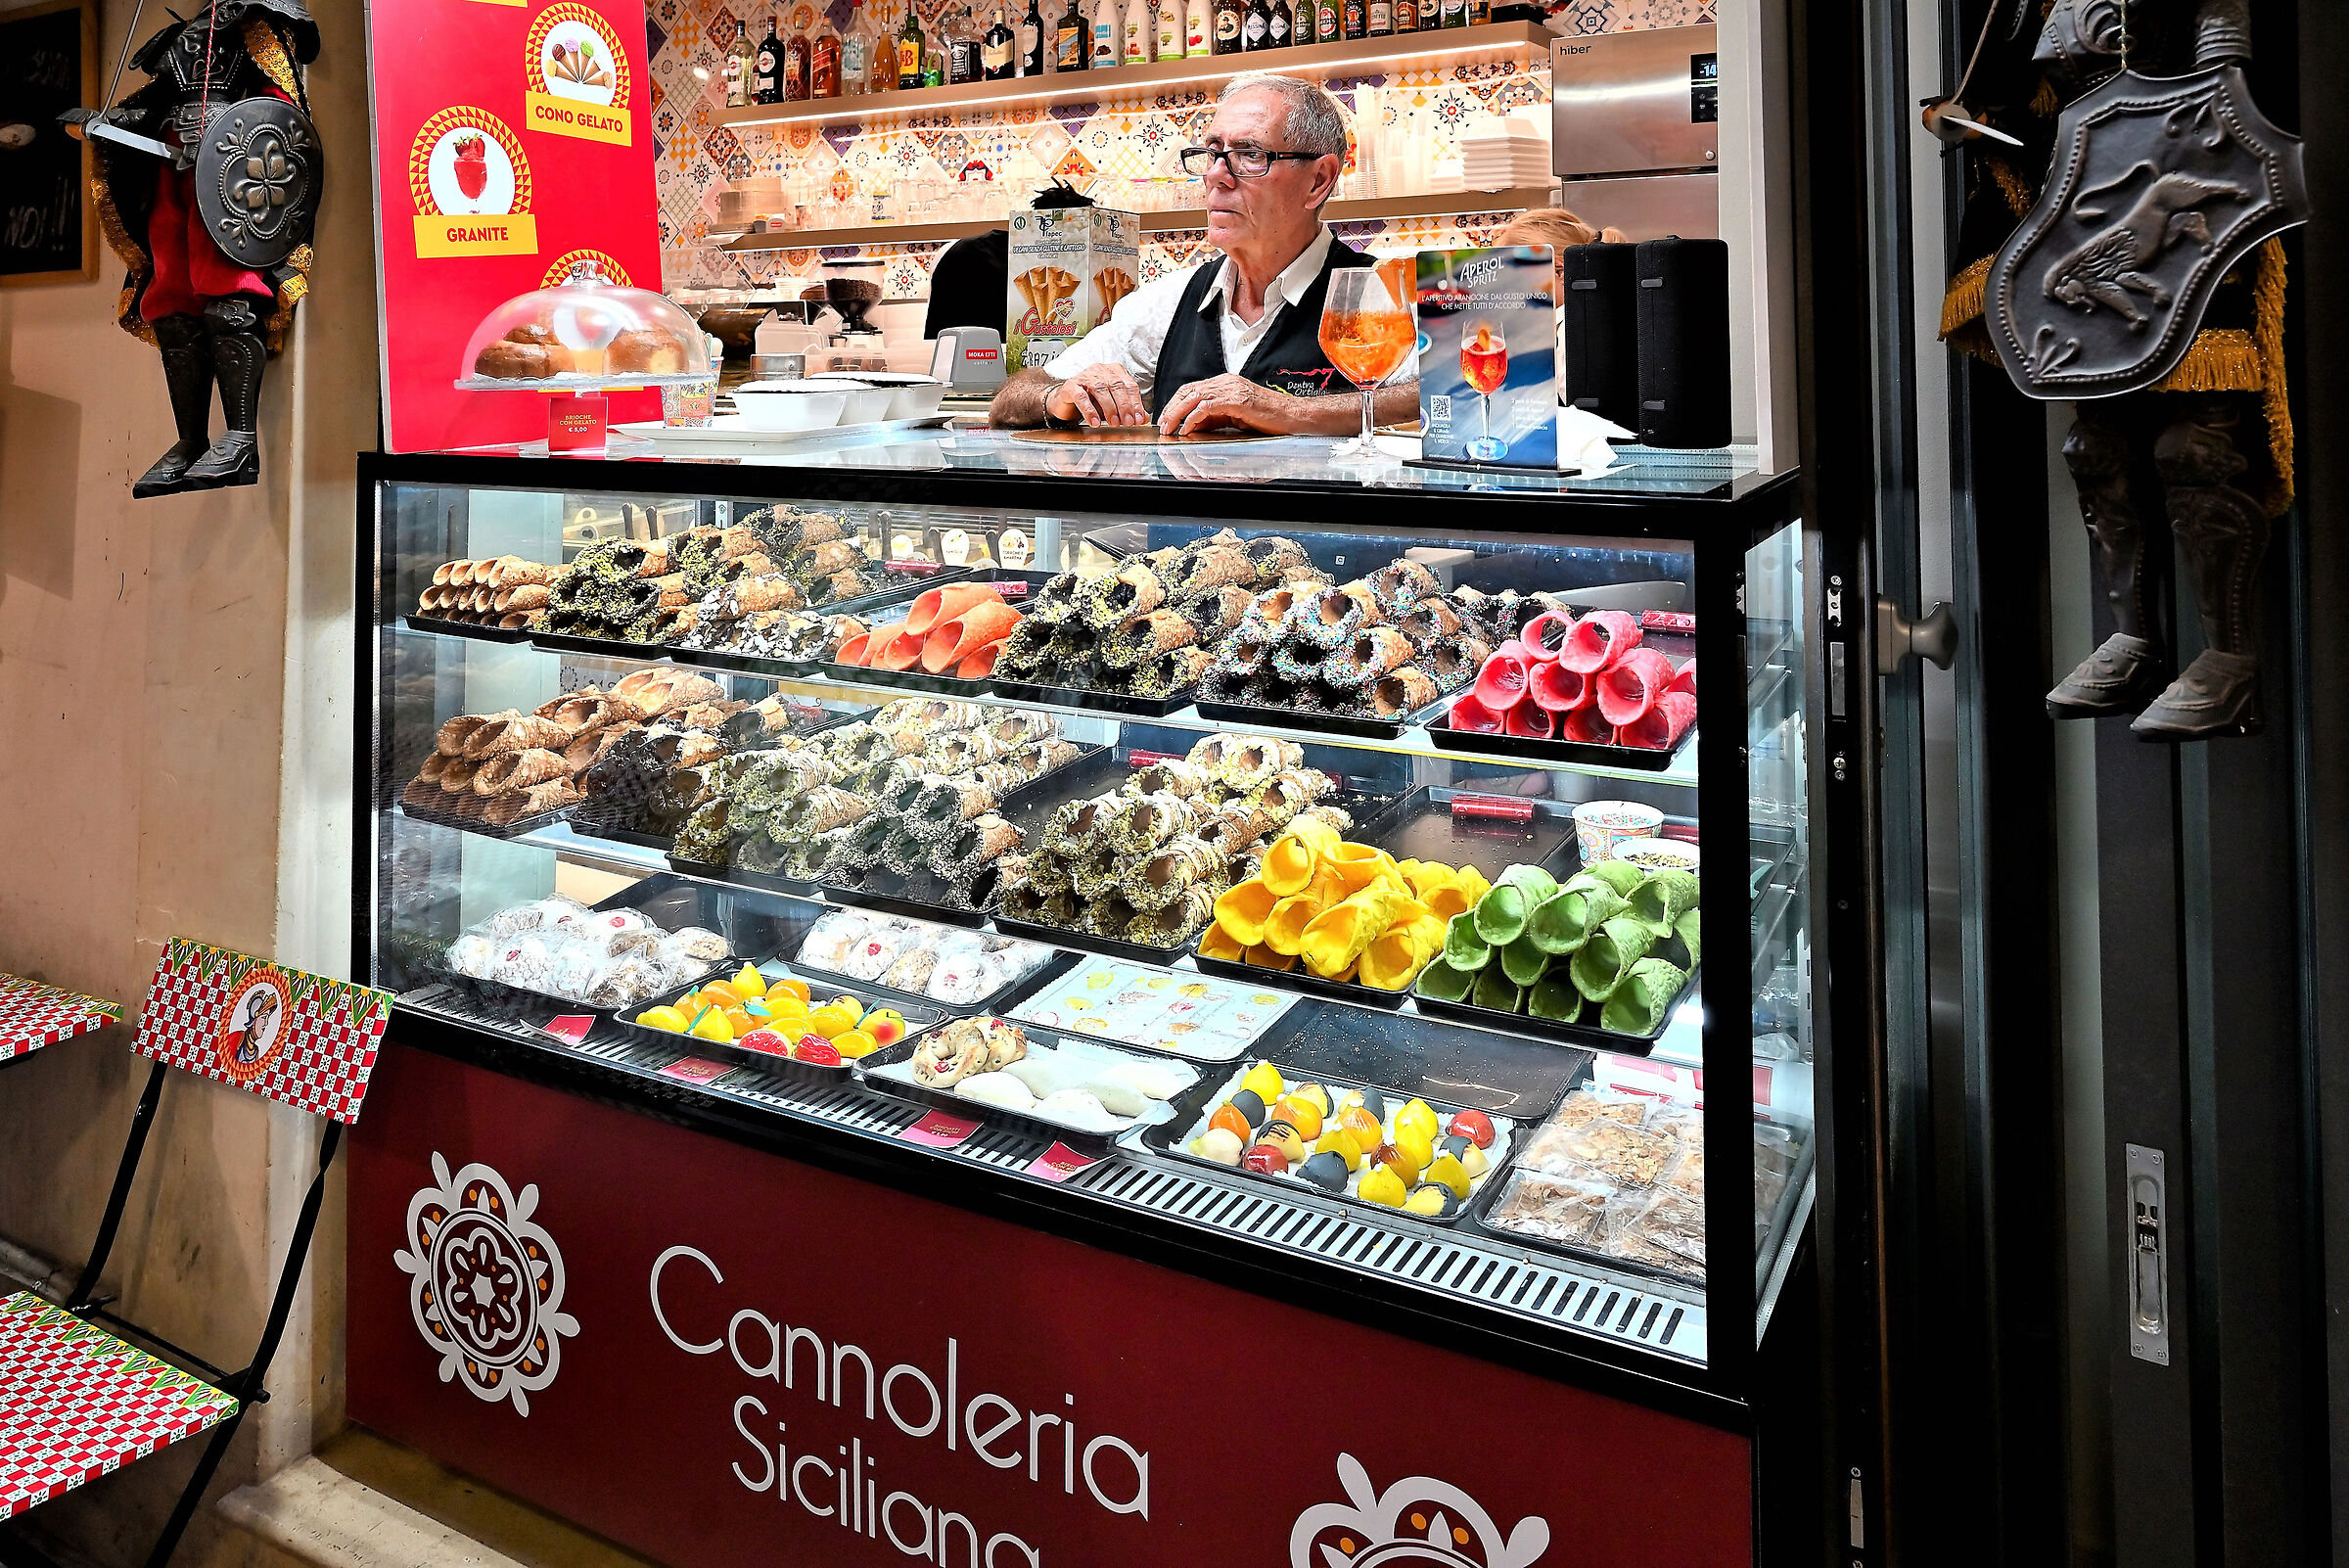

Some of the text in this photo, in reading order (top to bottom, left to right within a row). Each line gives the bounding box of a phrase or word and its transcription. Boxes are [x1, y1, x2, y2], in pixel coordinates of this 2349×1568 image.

[1559, 45, 1591, 56] hiber
[534, 105, 623, 133] CONO GELATO
[446, 226, 509, 243] GRANITE
[1460, 256, 1504, 282] APEROL
[1468, 271, 1497, 289] SPRITZ
[1489, 301, 1526, 310] D'ACCORDO
[1286, 381, 1314, 390] Dentro
[650, 1245, 1149, 1522] Cannoleria
